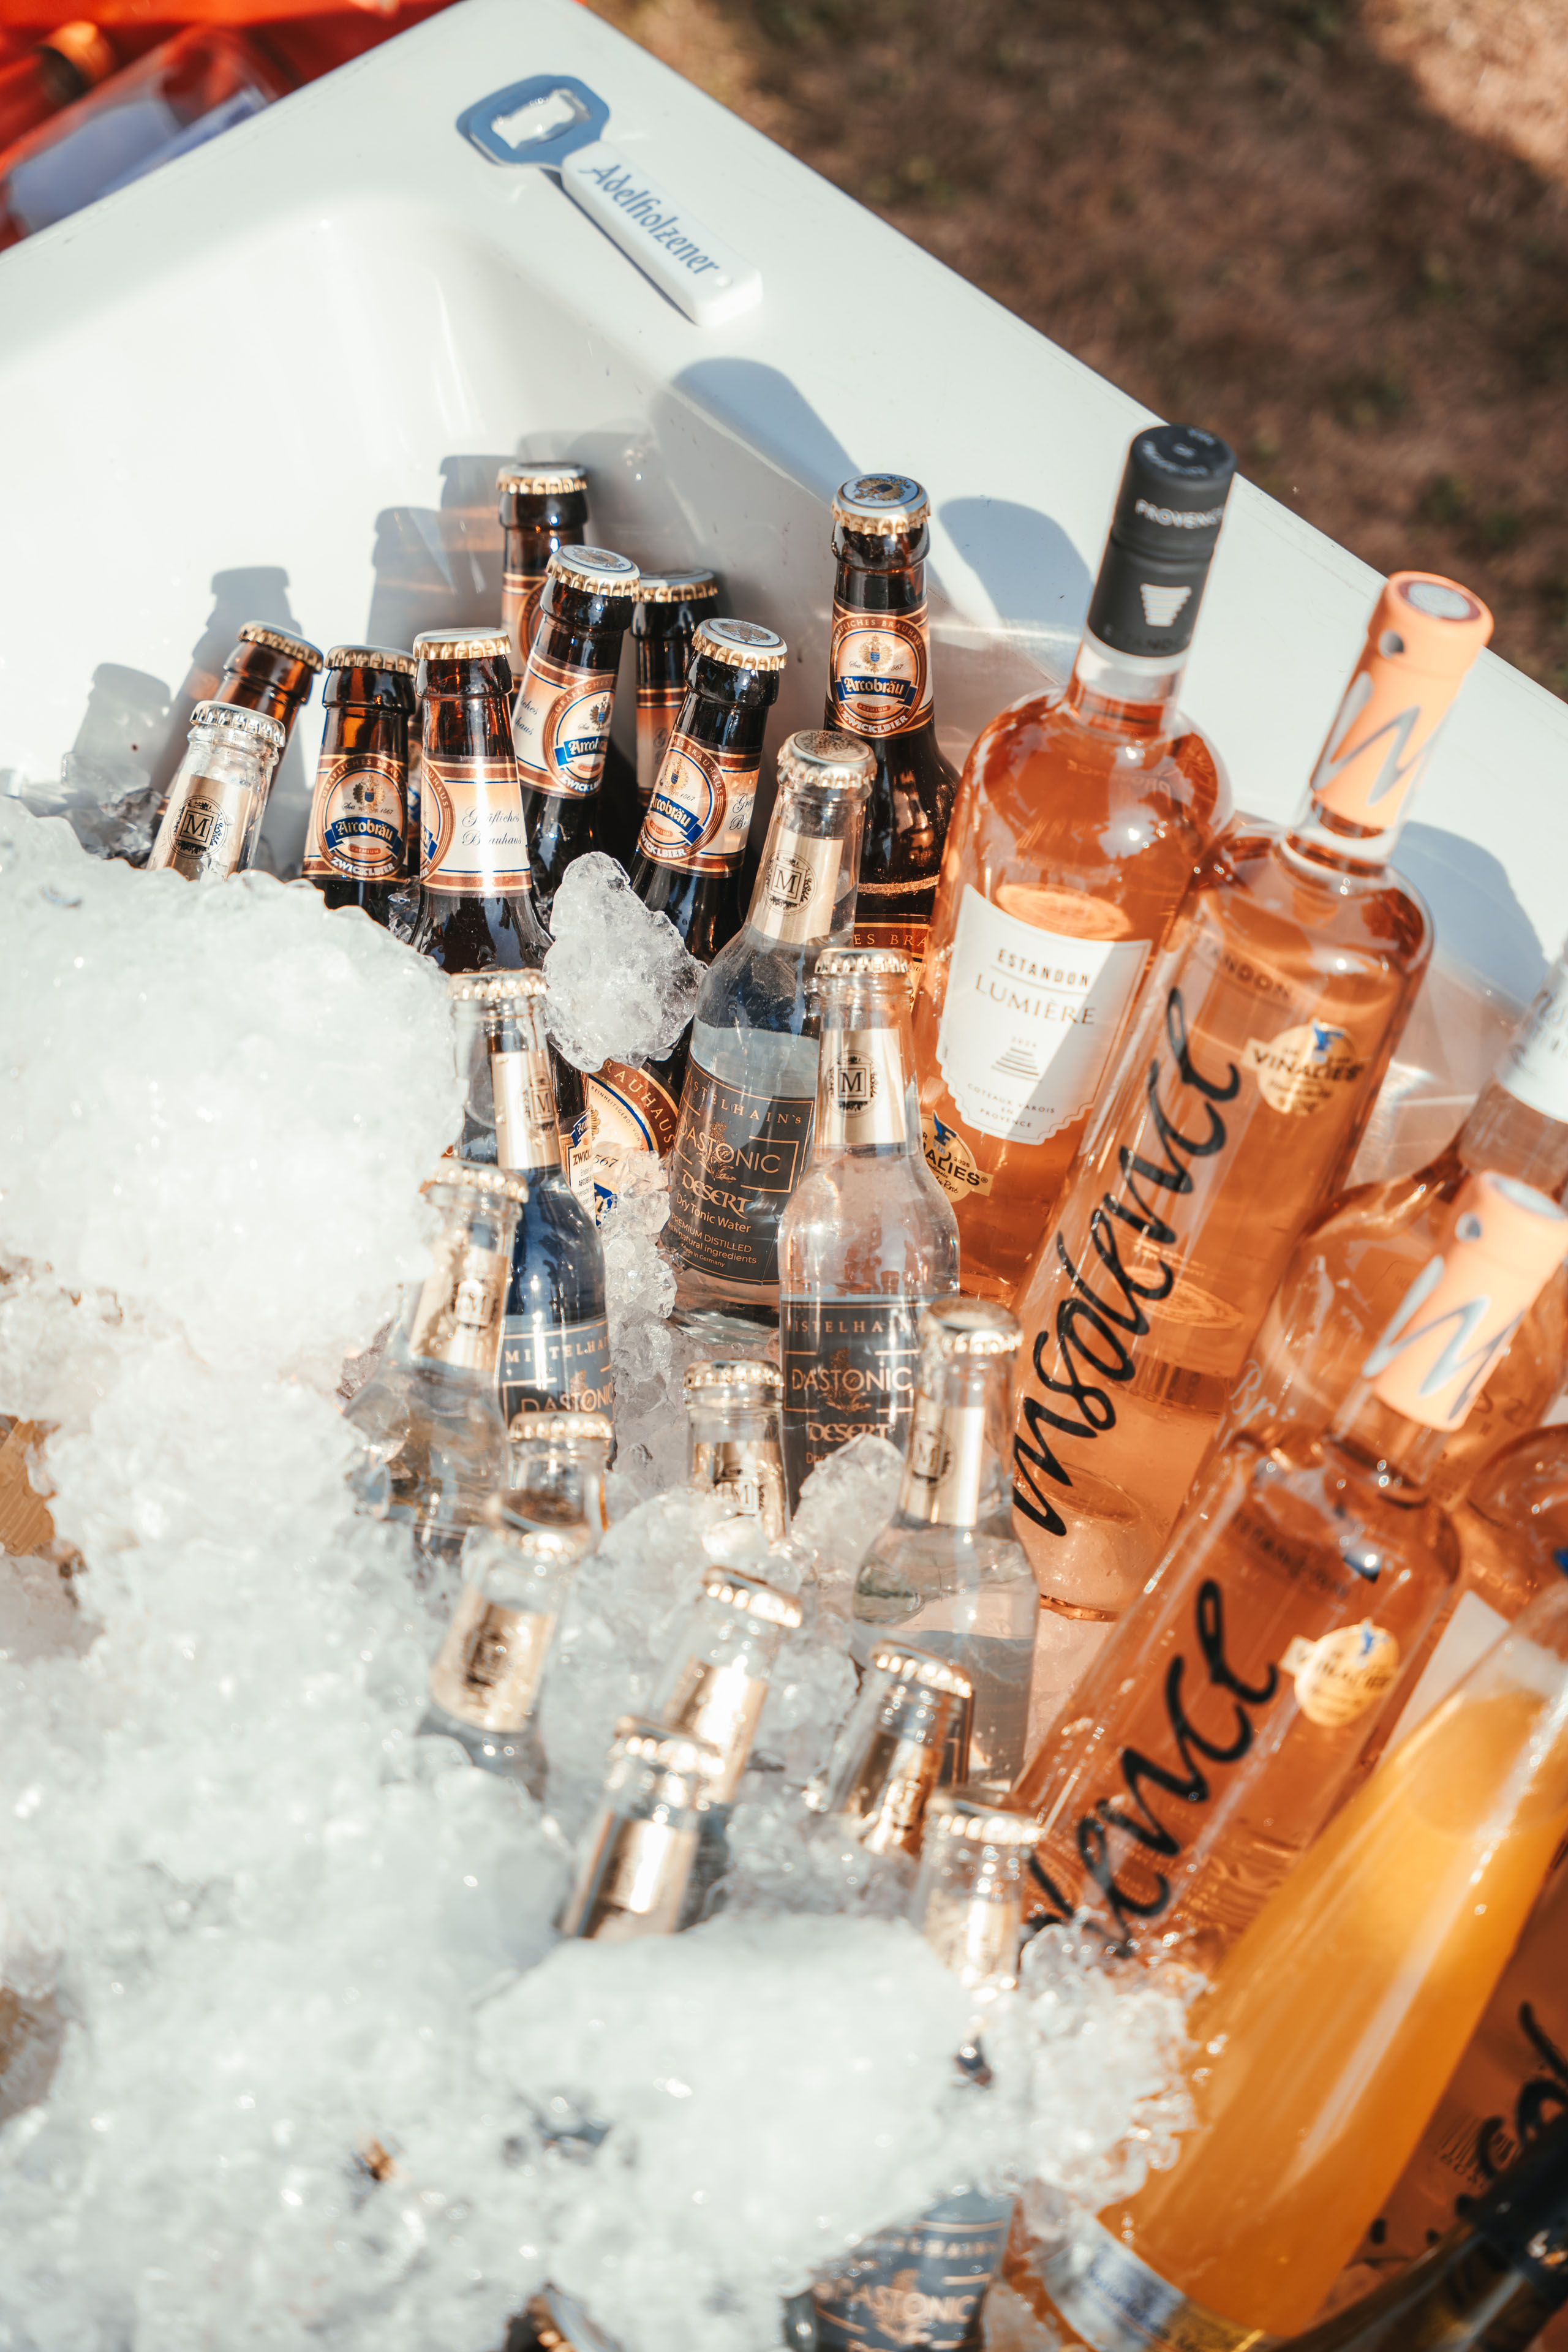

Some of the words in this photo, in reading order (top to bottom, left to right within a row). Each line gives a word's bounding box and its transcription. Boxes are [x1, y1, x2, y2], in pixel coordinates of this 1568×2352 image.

[578, 164, 720, 275] Adelholzener
[843, 677, 905, 696] Arcobräu
[841, 710, 909, 734] ZWICKLBIER
[687, 745, 723, 794] BRAUHAUS
[680, 793, 696, 802] 1567
[184, 814, 210, 839] M
[336, 820, 393, 841] Arcobräu
[331, 856, 395, 876] ZWICKLBIER
[774, 869, 799, 894] M
[997, 948, 1091, 987] ESTANDON
[975, 973, 1096, 1024] LUMIÈRE
[840, 1071, 862, 1093] M
[536, 1093, 551, 1114] M
[590, 1085, 633, 1127] REINHEITSGEBOT
[603, 1060, 676, 1144] RAUHAUS
[1001, 1107, 1014, 1115] EN
[980, 1108, 1032, 1128] PROVENCE
[678, 1114, 781, 1174] DASTONIC
[592, 1153, 619, 1168] 567
[681, 1168, 755, 1219] DESERT
[676, 1193, 690, 1212] Dry
[691, 1203, 715, 1224] Tonic
[718, 1215, 752, 1234] Water
[671, 1213, 703, 1240] PREMIUM
[704, 1234, 752, 1253] DISTILLED
[678, 1231, 703, 1250] natural
[704, 1245, 758, 1264] ingredients
[699, 1254, 725, 1268] Germany
[791, 1366, 913, 1392] DASTONIC
